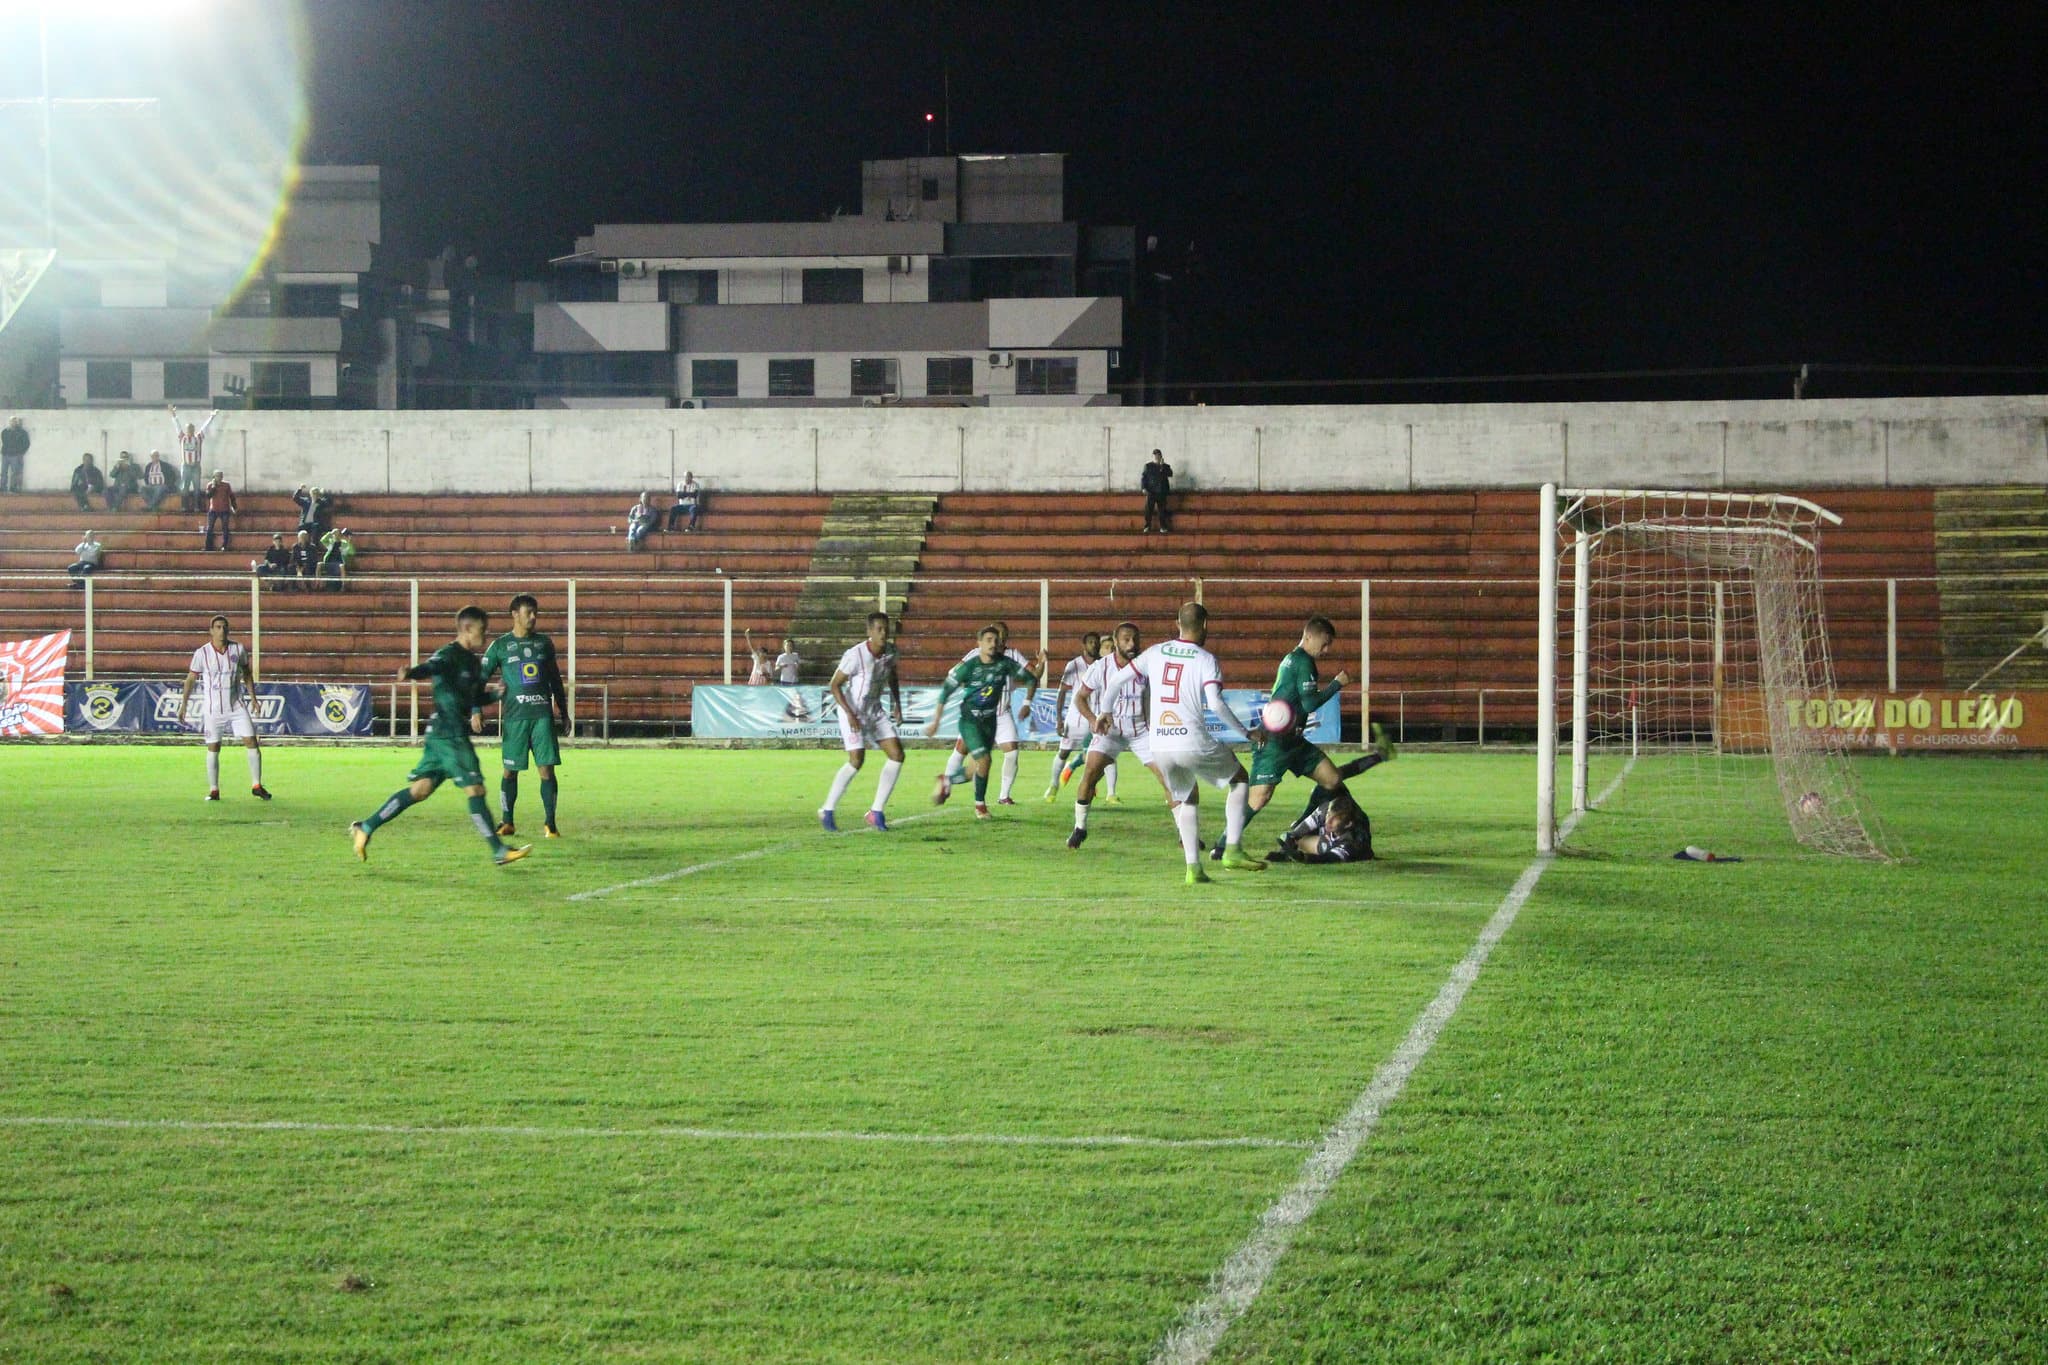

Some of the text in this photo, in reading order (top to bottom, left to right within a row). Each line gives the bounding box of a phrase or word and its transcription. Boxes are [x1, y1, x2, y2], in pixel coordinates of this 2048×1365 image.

[1160, 661, 1184, 704] 9
[1786, 693, 2024, 729] TOCA DO LEÃO
[1156, 727, 1188, 737] PIUCCO
[1897, 734, 1905, 745] E
[1913, 733, 2019, 745] CHURRASCARIA
